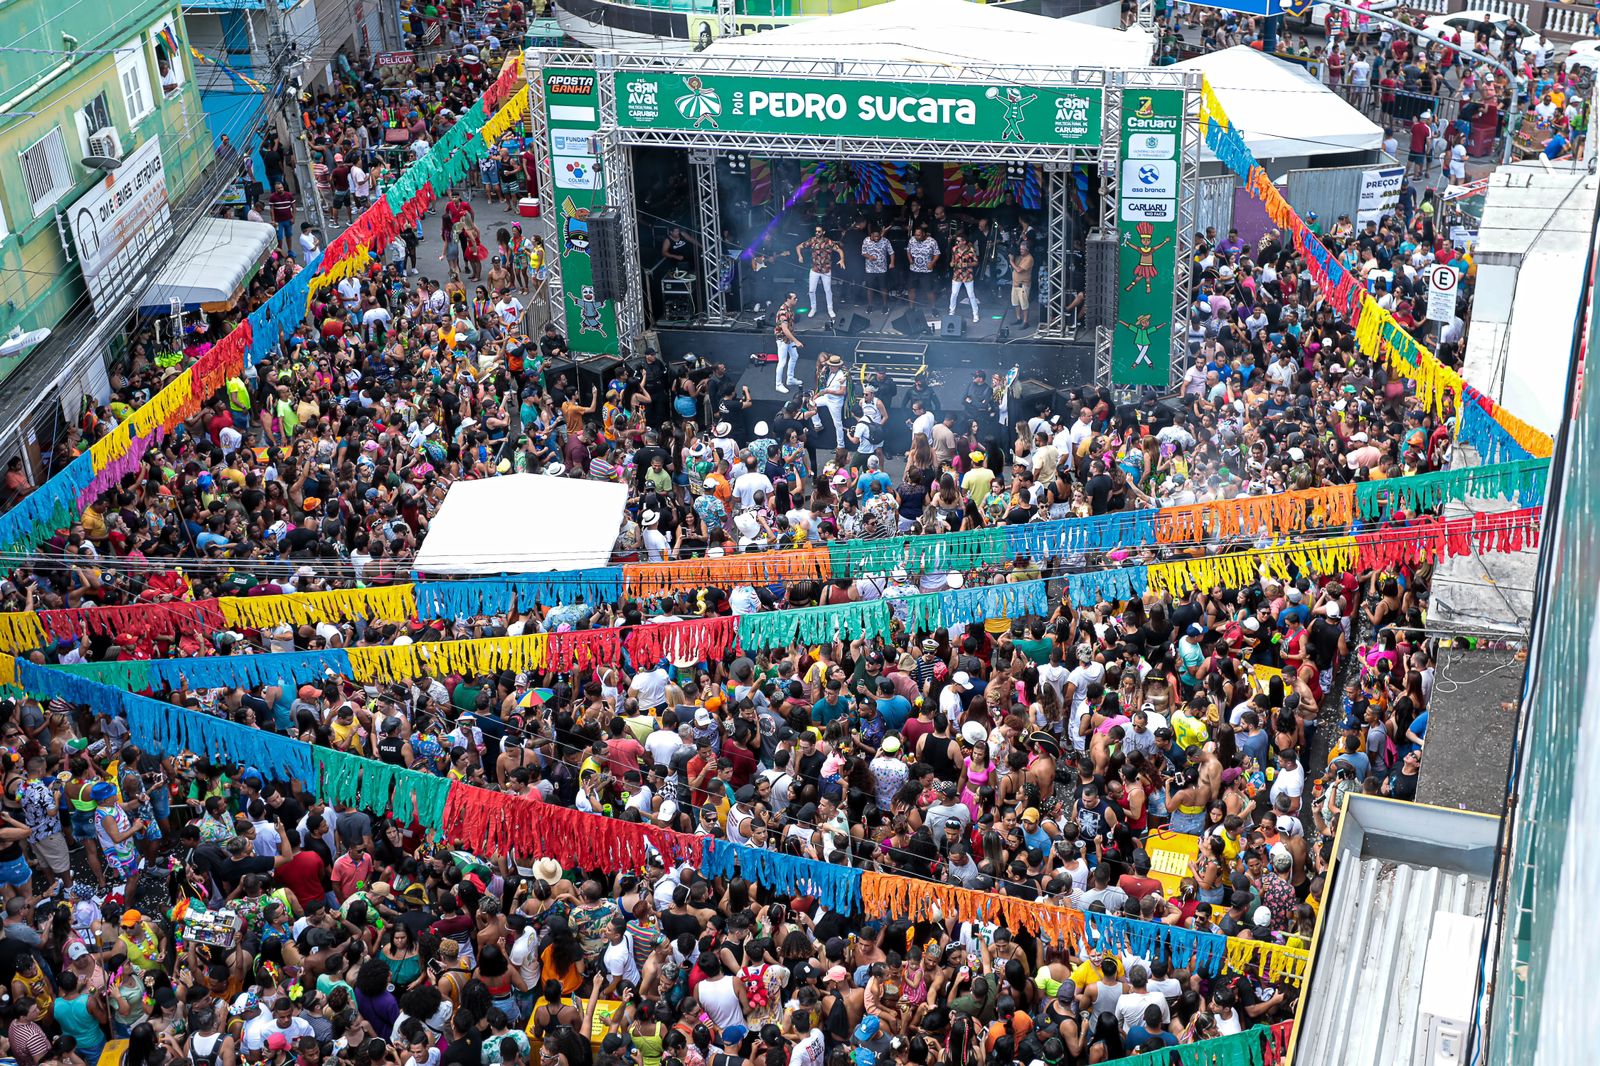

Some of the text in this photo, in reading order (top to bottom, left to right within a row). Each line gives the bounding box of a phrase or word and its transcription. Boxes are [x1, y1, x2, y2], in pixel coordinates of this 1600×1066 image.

[548, 76, 594, 86] APOSTA
[552, 84, 591, 94] GANHA
[749, 91, 847, 122] PEDRO
[1128, 117, 1176, 128] Caruaru
[1366, 178, 1399, 189] PREÇOS
[1129, 203, 1167, 211] CARUARU
[1439, 271, 1448, 285] E
